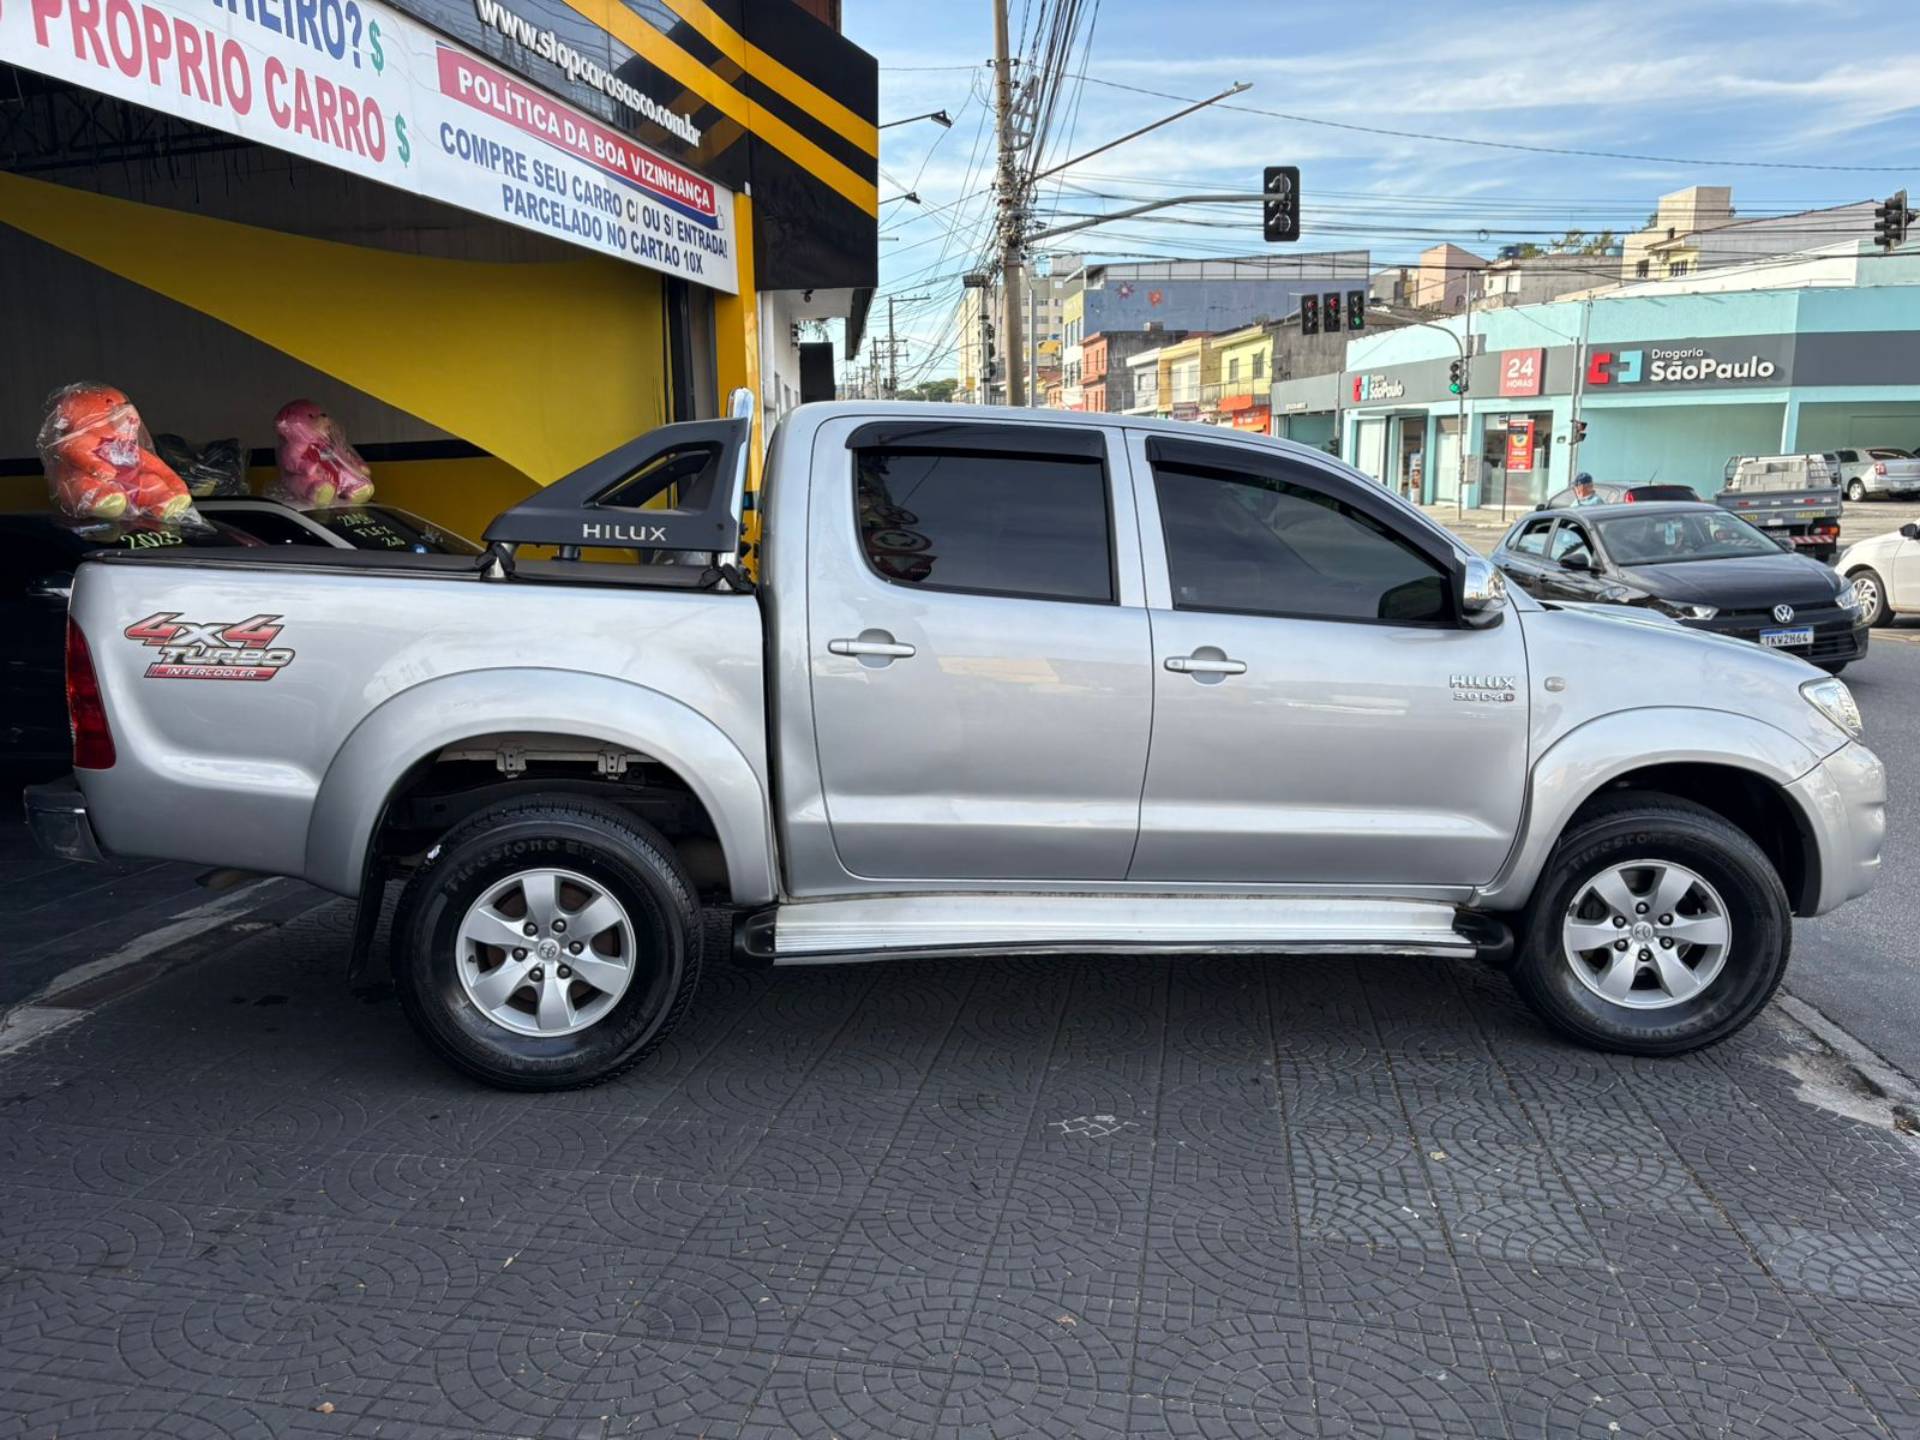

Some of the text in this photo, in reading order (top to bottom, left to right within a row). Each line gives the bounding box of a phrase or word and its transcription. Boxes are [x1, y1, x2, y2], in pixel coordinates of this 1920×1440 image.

[475, 0, 702, 147] www.stopcarosasco.com.br
[264, 56, 386, 163] CARRO
[458, 66, 711, 210] POLÍTICA DA BOA VIZINHANÇA
[440, 122, 529, 183] COMPRE
[532, 159, 567, 197] SEU
[572, 175, 623, 218] CARRO
[642, 205, 661, 232] OU
[677, 219, 728, 259] ENTRADA!
[502, 183, 602, 243] PARCELADO
[606, 220, 627, 251] NO
[683, 248, 704, 275] 10X
[1651, 347, 1704, 361] Drogaria
[1506, 357, 1535, 379] 24
[1506, 379, 1534, 388] HORAS
[120, 531, 183, 550] 2023
[583, 523, 667, 541] HILUX
[159, 646, 296, 667] TURBO
[166, 666, 258, 678] INTERCOOLER
[1449, 675, 1515, 690] HILUX
